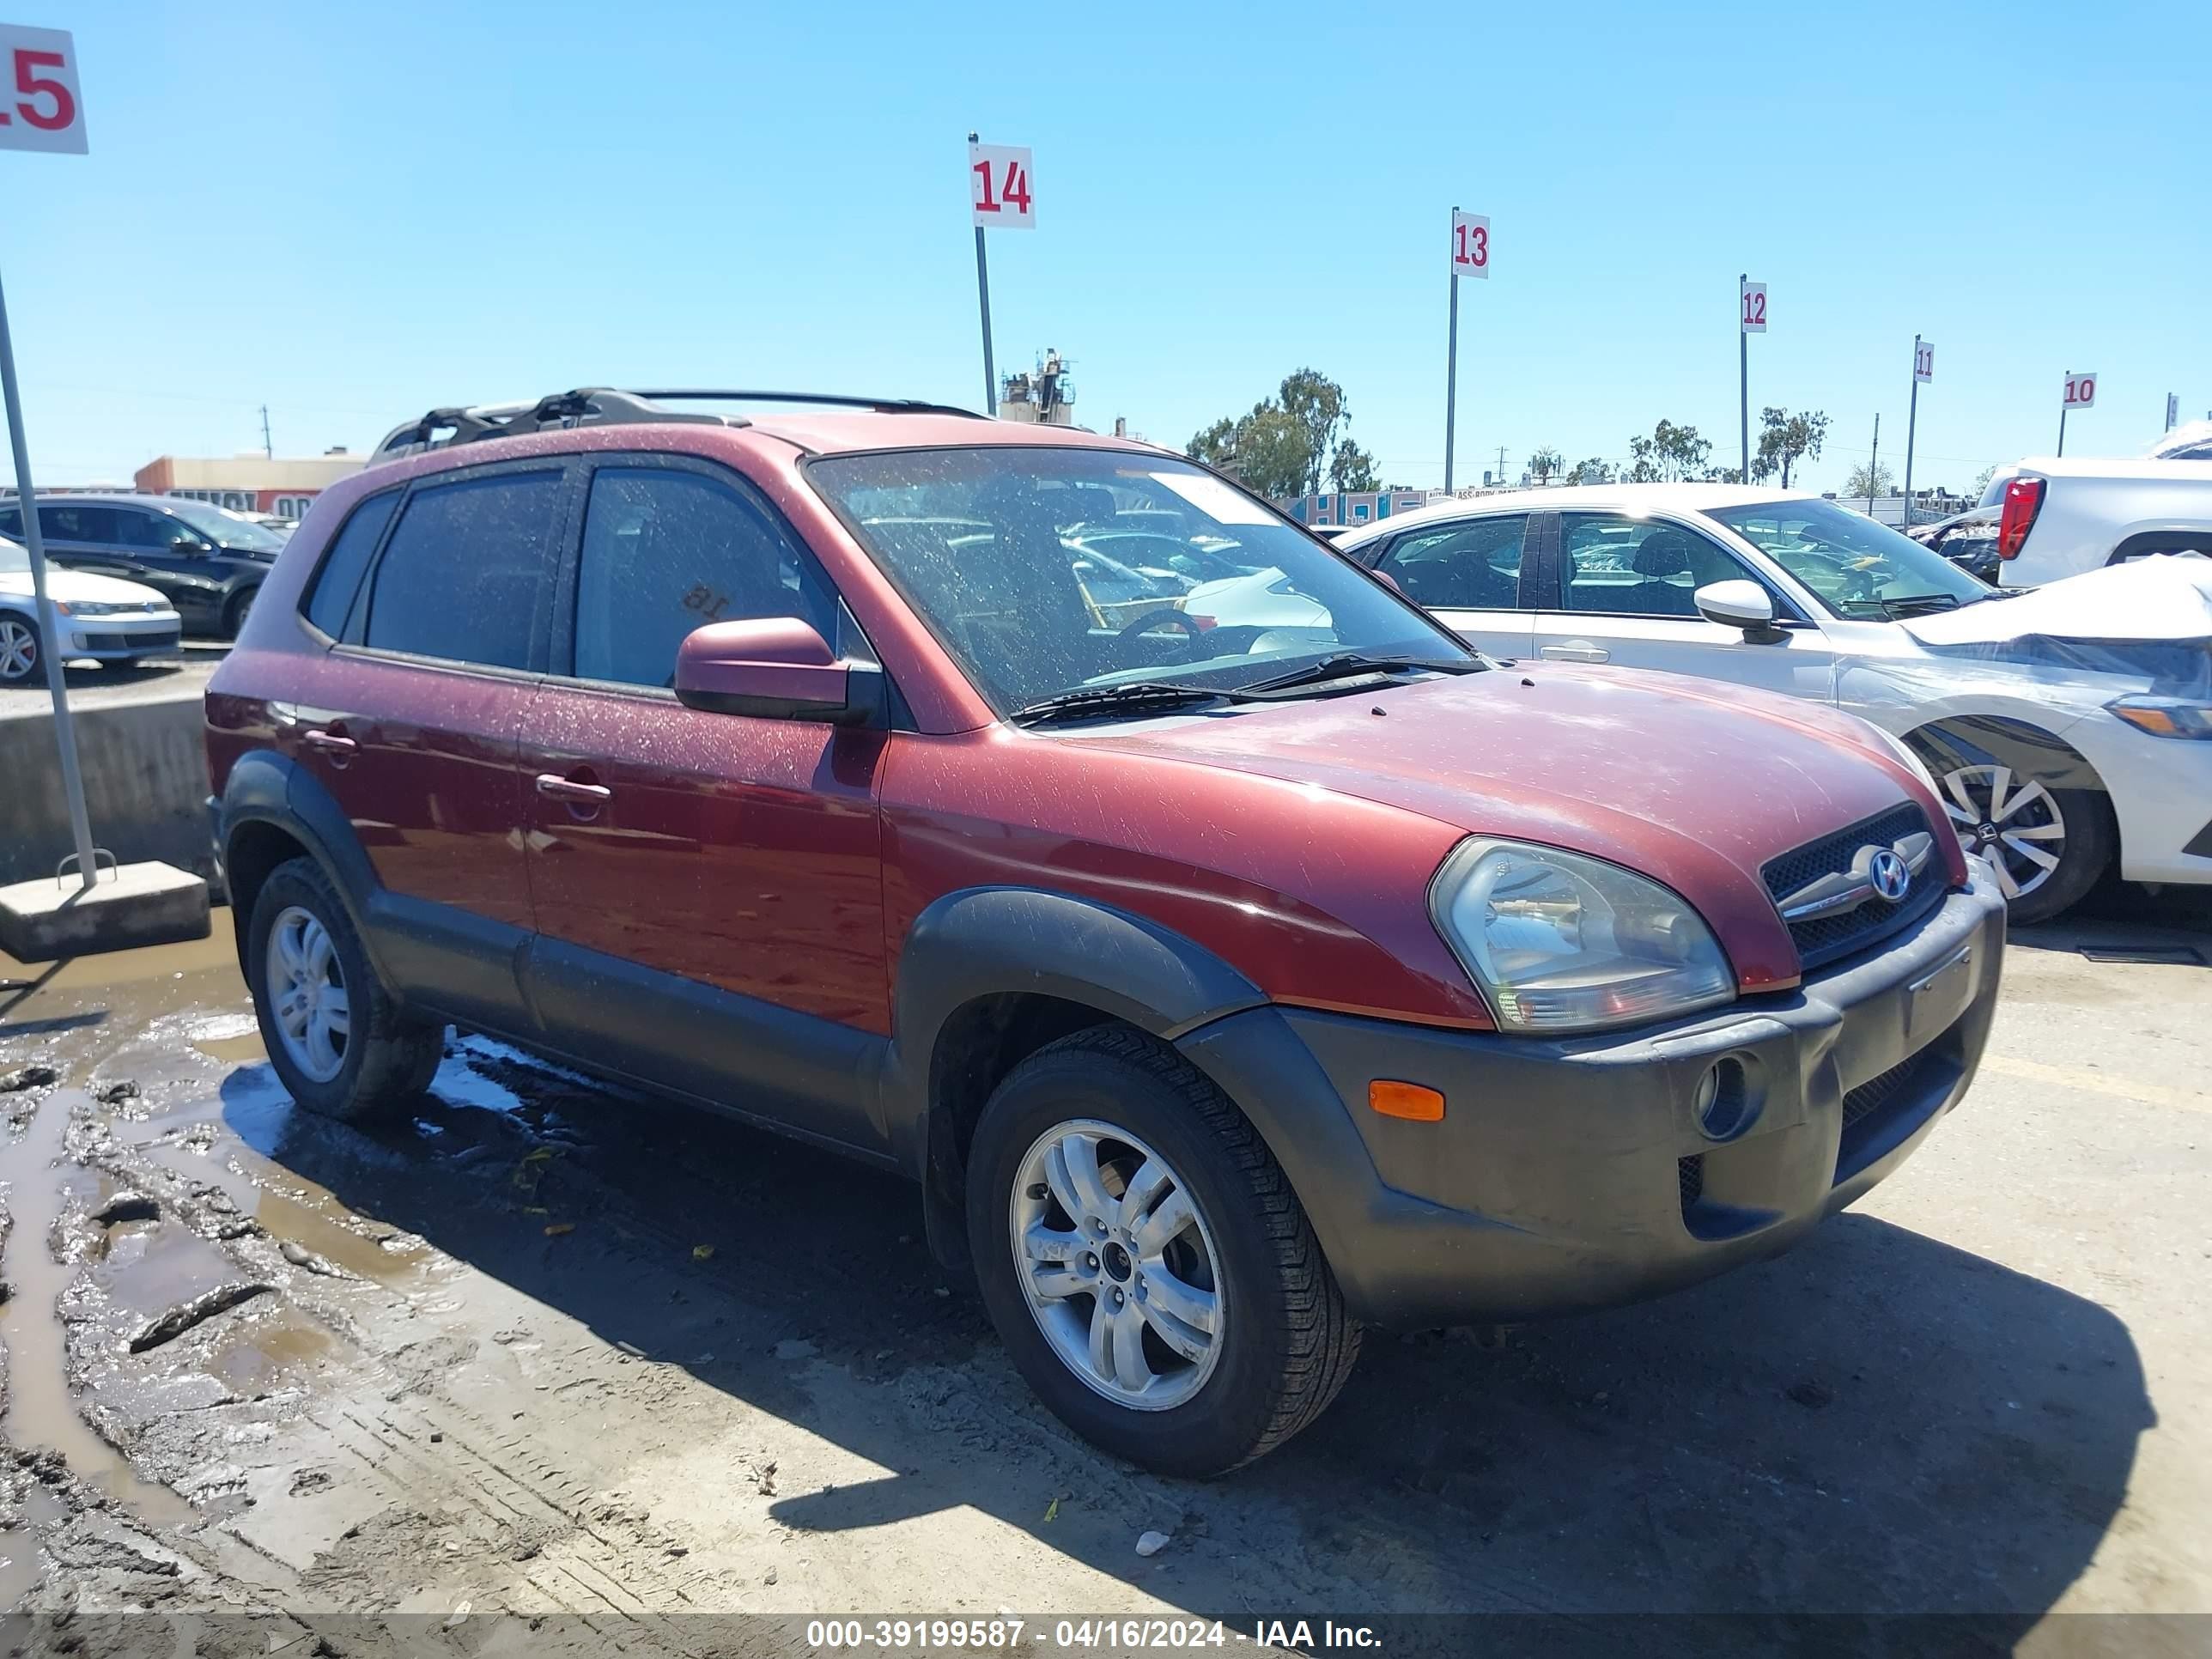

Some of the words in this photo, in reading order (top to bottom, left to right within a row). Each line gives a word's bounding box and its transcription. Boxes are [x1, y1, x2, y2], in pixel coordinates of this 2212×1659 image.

[0, 48, 76, 131] 5
[973, 160, 1031, 214] 14
[1455, 224, 1487, 267] 13
[1744, 292, 1765, 325] 12
[1917, 349, 1932, 377] 11
[2063, 379, 2095, 404] 10
